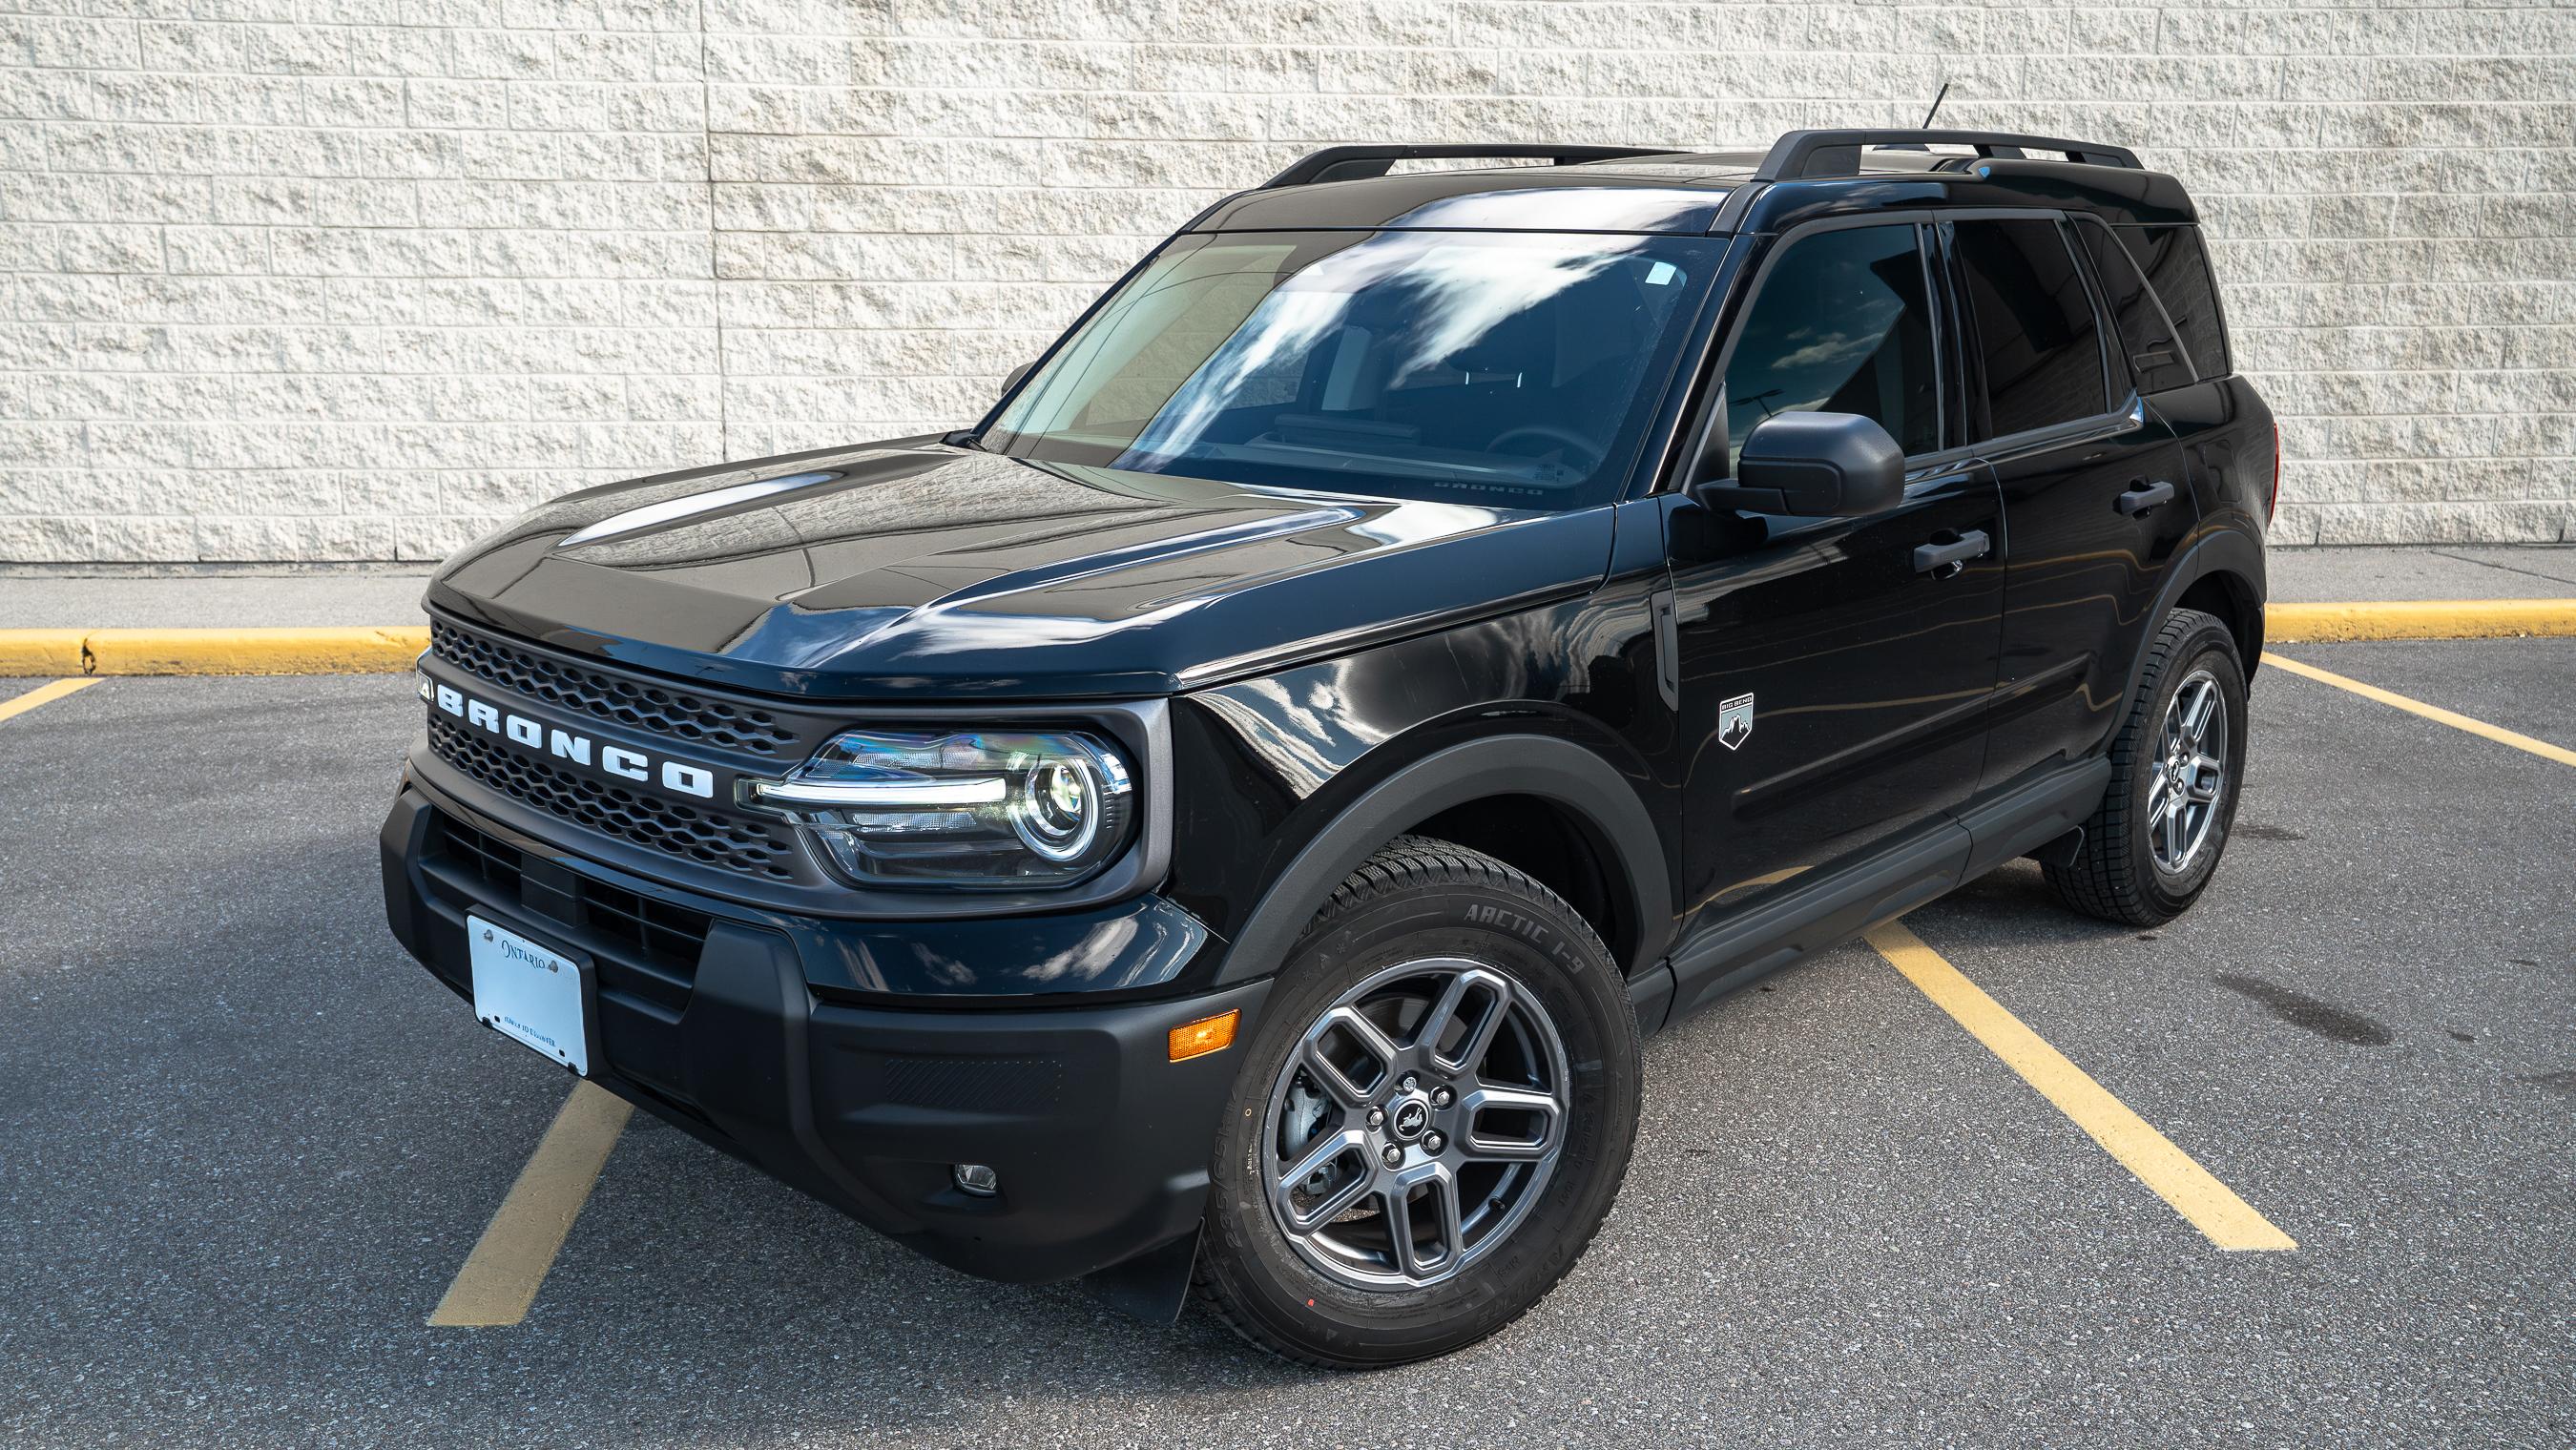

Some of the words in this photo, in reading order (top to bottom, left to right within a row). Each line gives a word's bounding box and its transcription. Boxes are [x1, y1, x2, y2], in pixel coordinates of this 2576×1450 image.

[1734, 697, 1751, 707] BEND
[437, 684, 714, 798] BRONCO
[1464, 903, 1548, 943] ARCTIC
[501, 940, 546, 969] ONTARIO
